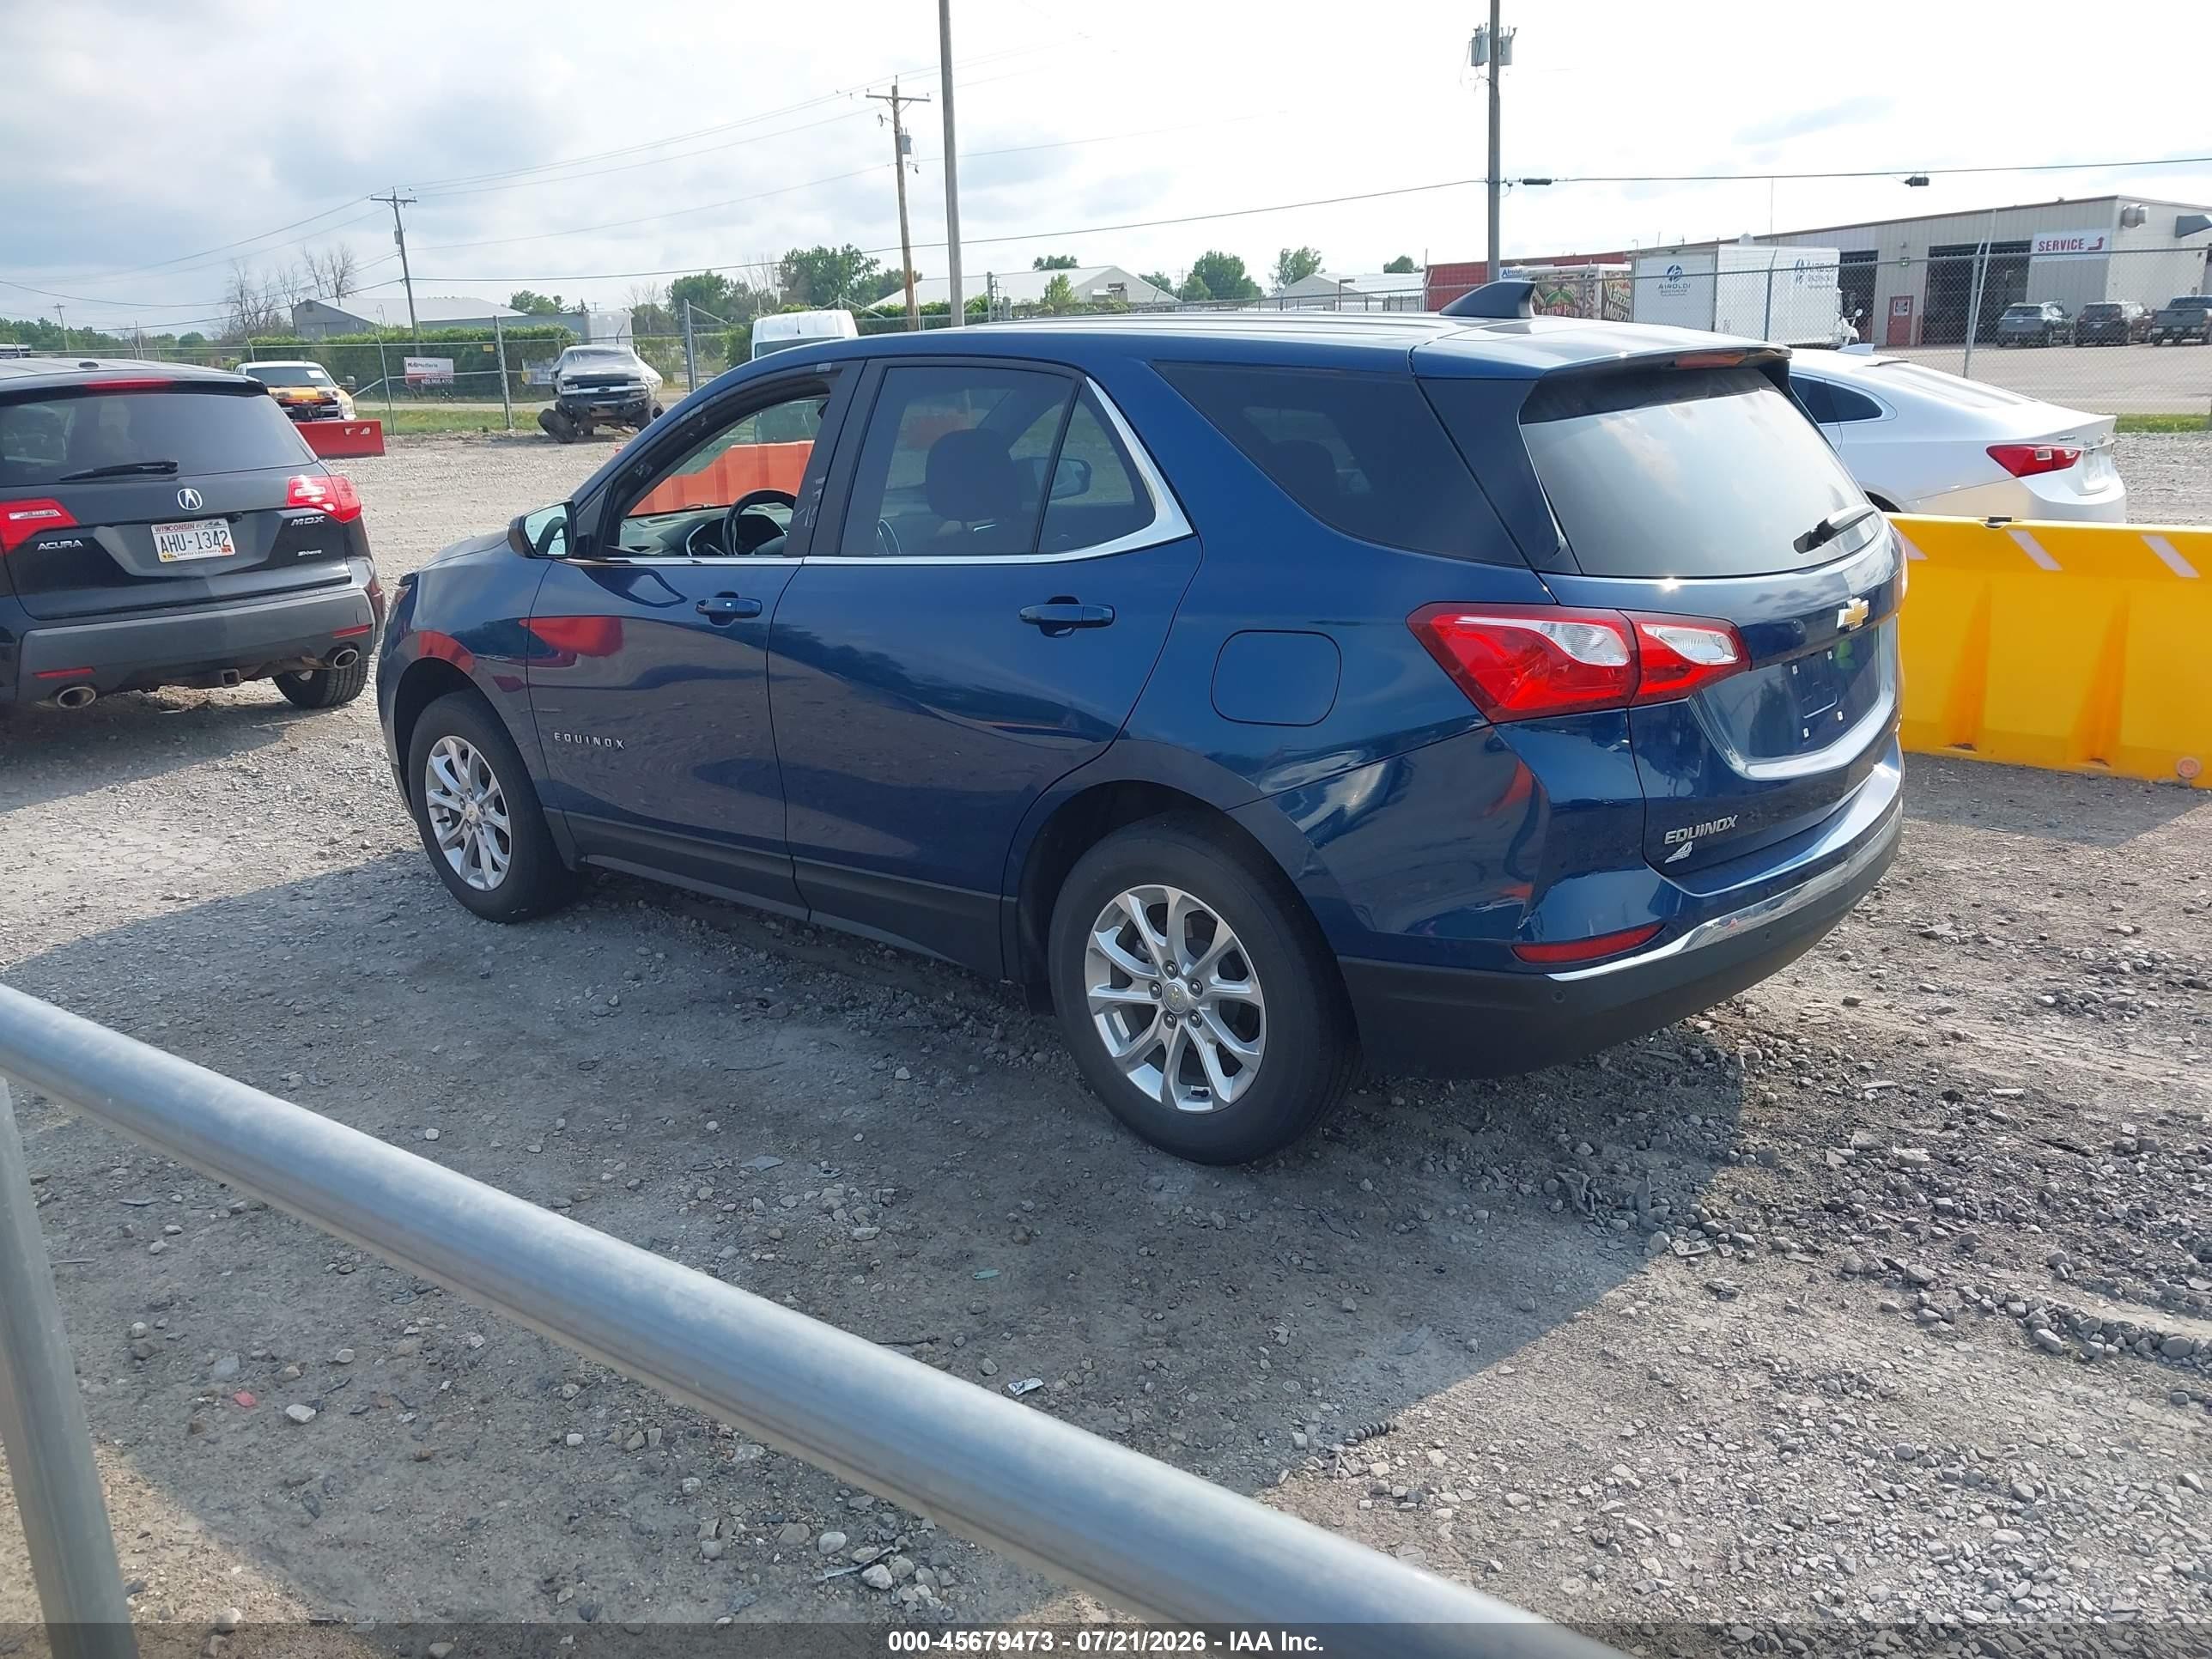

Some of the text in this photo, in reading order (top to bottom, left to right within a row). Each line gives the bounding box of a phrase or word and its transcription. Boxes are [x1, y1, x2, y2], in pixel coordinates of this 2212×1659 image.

[2038, 238, 2085, 252] SERVICE
[155, 522, 195, 532] WISCONSIN
[290, 515, 325, 526] MDX
[37, 539, 83, 550] ACURA
[160, 530, 231, 554] AHU-1342
[554, 732, 625, 750] EQUINOX
[1664, 814, 1739, 845] EQUINOX
